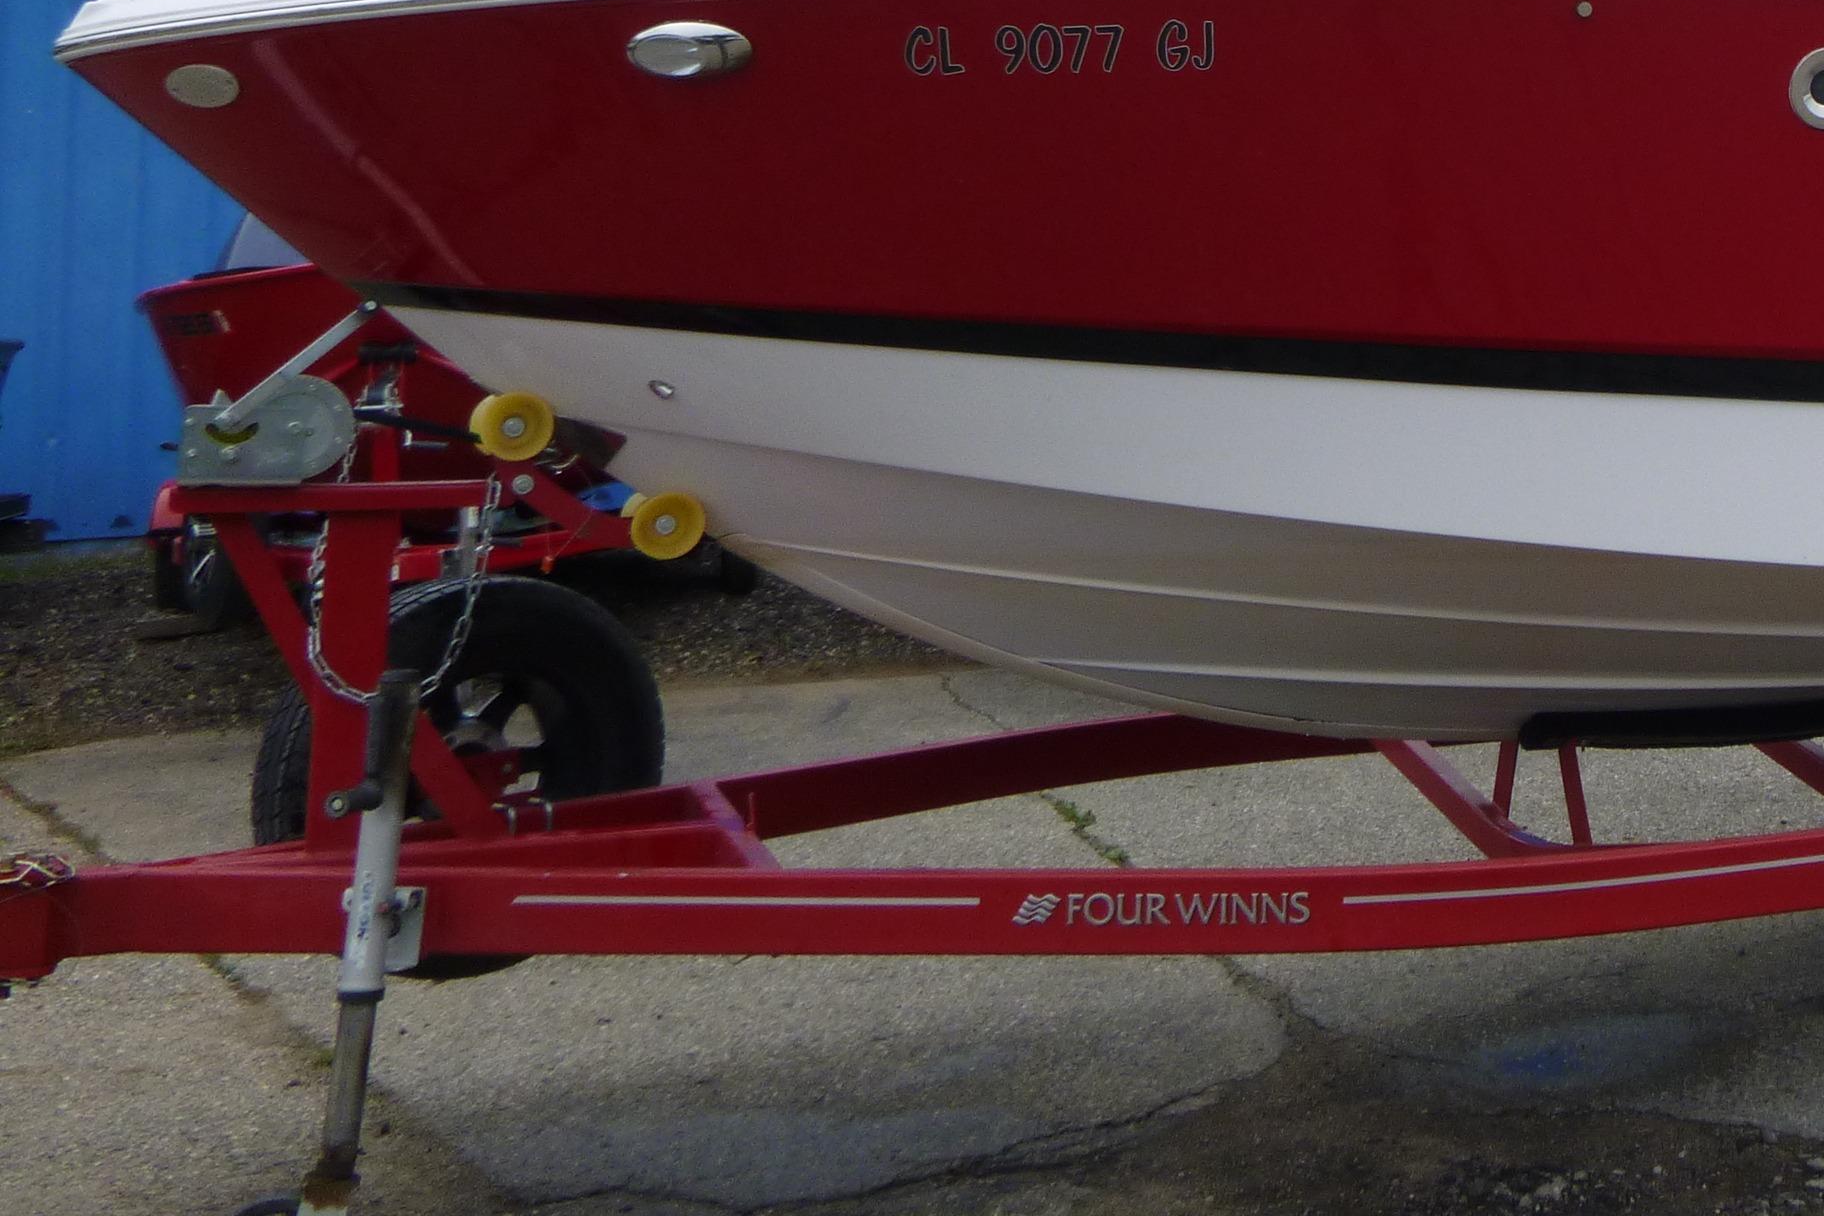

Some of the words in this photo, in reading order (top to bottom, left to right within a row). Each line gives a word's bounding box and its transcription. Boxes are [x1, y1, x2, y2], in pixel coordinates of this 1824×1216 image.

[904, 26, 966, 76] CL
[995, 23, 1124, 75] 9077
[1156, 19, 1214, 71] GJ
[1066, 892, 1172, 926] FOUR
[1174, 891, 1311, 926] WINNS
